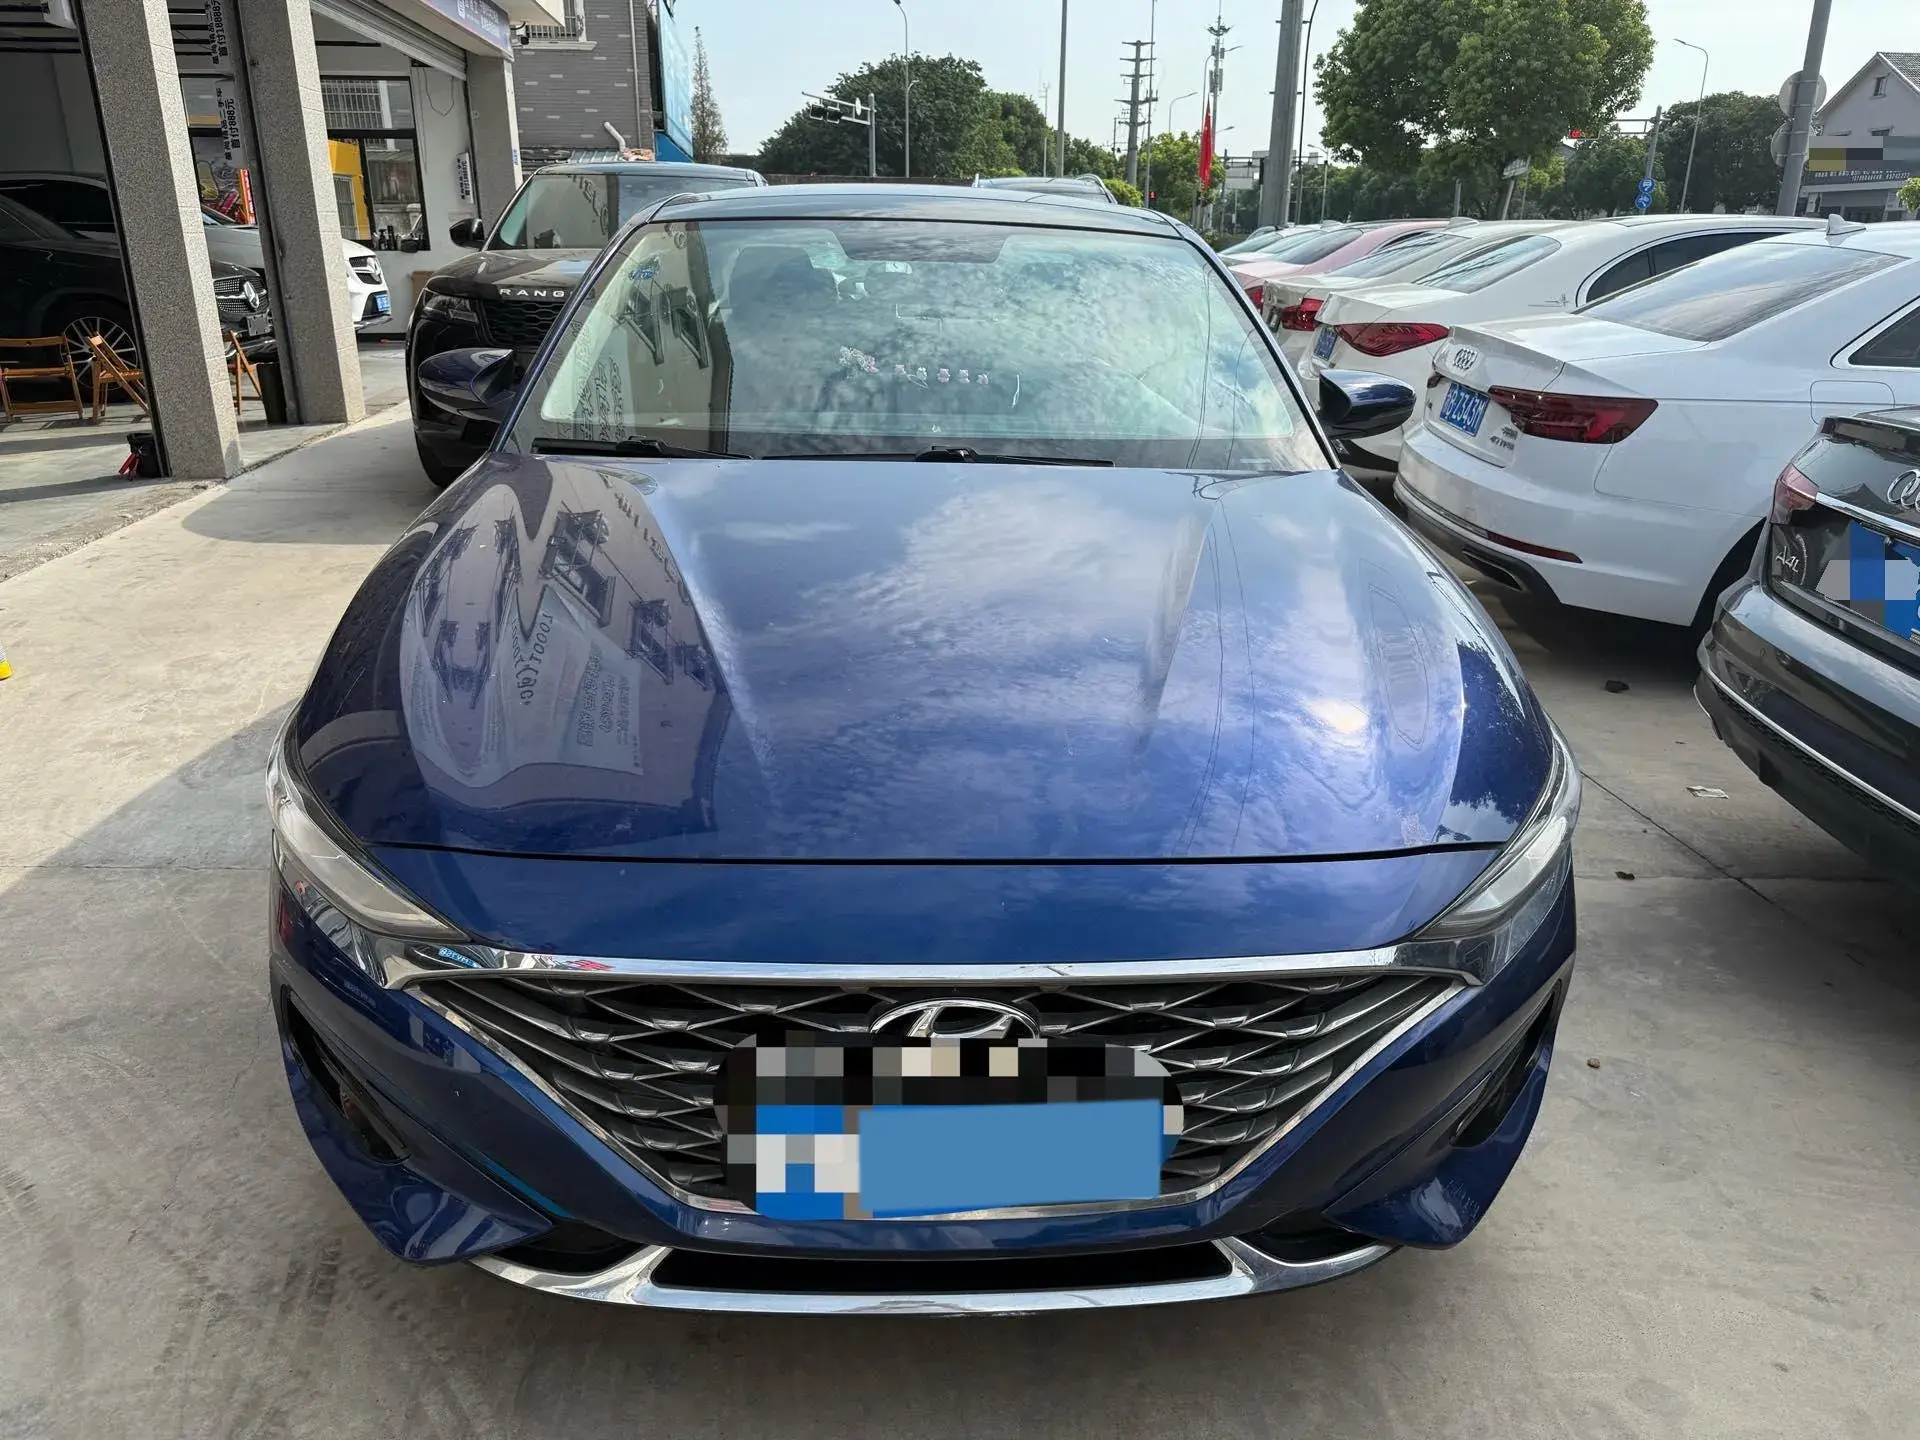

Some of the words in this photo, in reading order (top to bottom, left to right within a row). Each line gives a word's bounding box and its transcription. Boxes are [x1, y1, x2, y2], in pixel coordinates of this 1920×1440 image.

[224, 98, 241, 149] 首付888元
[1775, 545, 1799, 573] A4L
